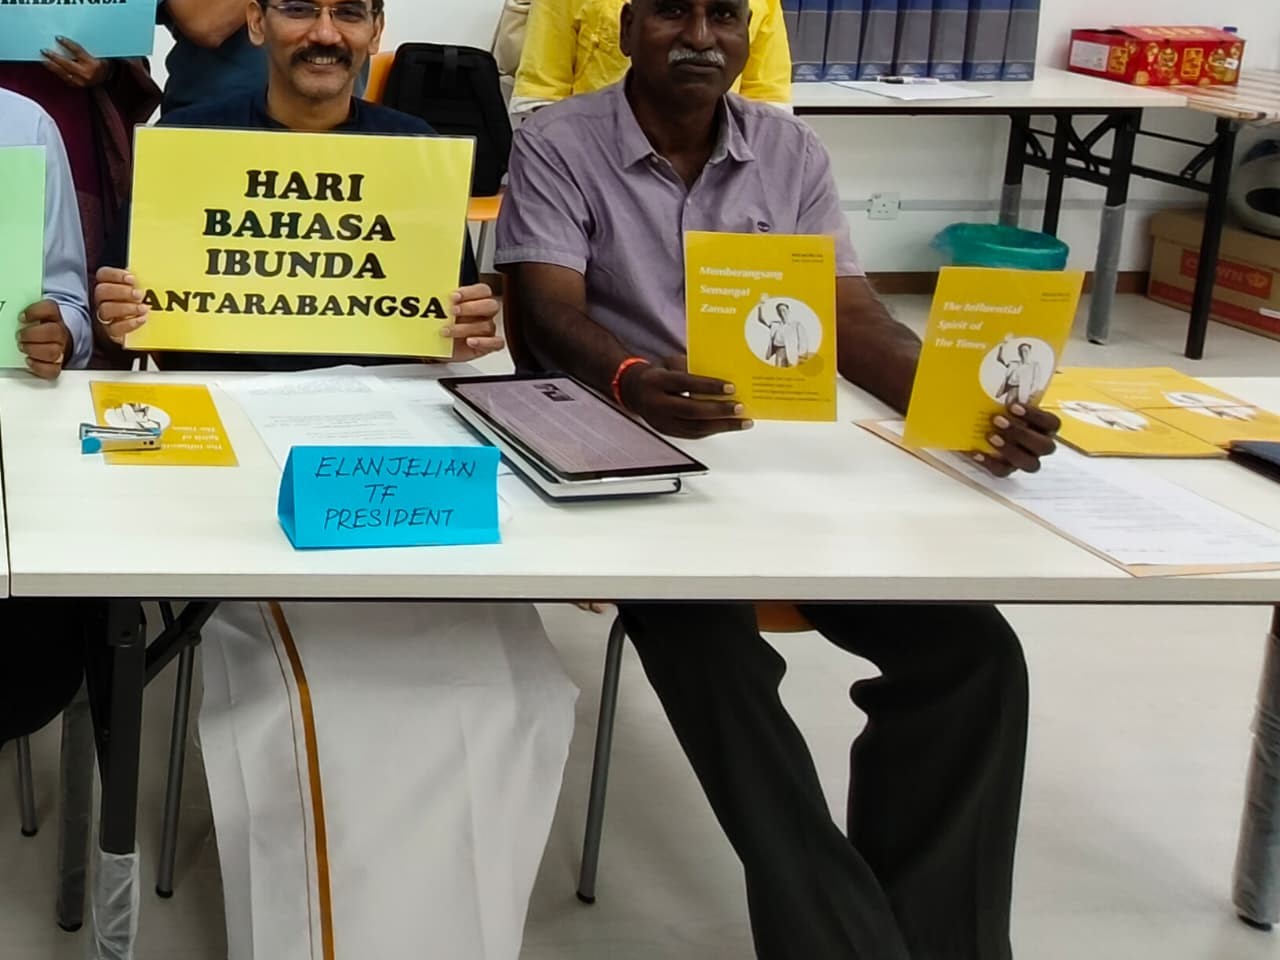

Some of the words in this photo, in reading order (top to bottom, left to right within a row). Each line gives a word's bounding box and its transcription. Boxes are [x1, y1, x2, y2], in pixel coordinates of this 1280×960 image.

[243, 169, 365, 202] HARI
[202, 208, 397, 242] BAHASA
[204, 248, 387, 280] IBUNDA
[142, 289, 448, 319] ANTARABANGSA
[969, 319, 984, 331] of
[314, 455, 477, 479] ELANJELIAN
[364, 483, 398, 504] TF
[323, 506, 455, 531] PRESIDENT
